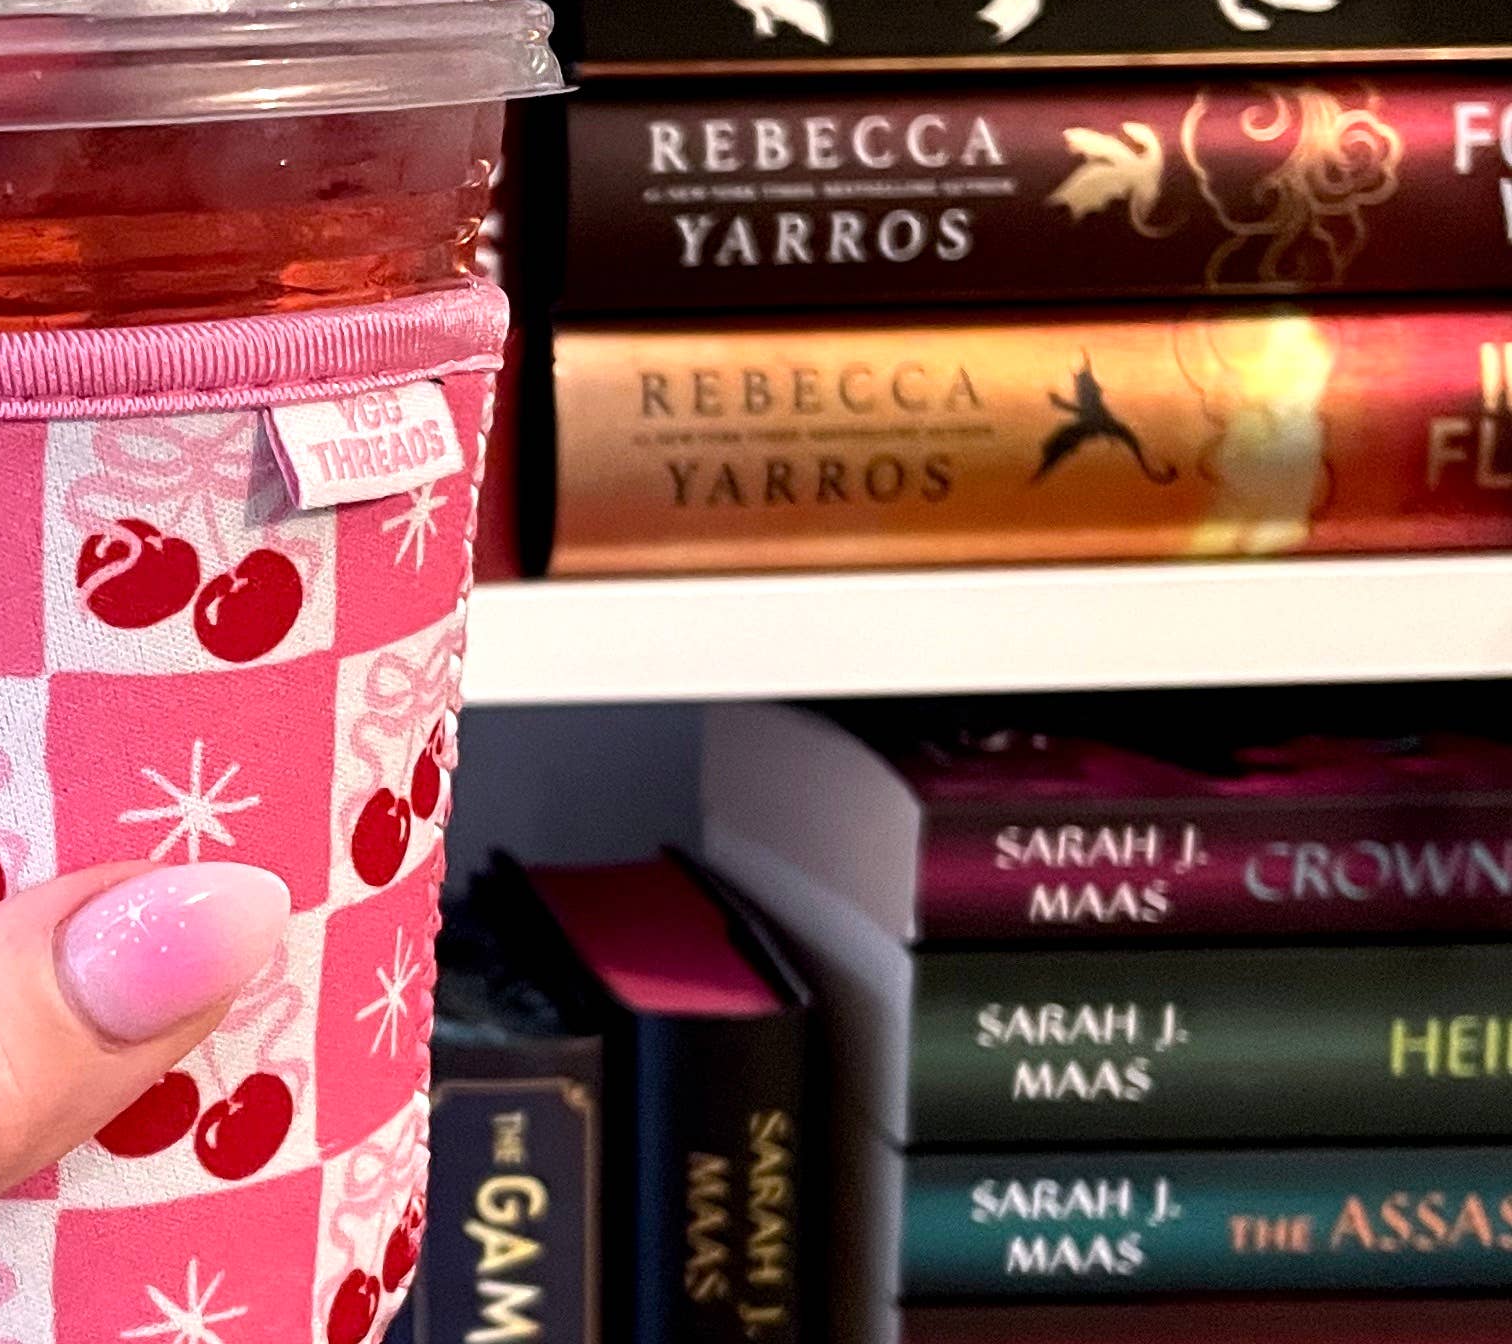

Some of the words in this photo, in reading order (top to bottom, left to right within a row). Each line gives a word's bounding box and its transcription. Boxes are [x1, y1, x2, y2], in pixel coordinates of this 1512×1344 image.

[646, 112, 1007, 176] REBECCA
[671, 206, 975, 268] YARROS
[637, 363, 985, 420] REBECCA
[307, 419, 448, 482] THREADS
[662, 455, 956, 509] YARROS
[994, 824, 1161, 871] SARAH
[1173, 821, 1209, 875] J.
[1029, 878, 1172, 923] MAAS
[976, 1001, 1142, 1047] SARAH
[1154, 1000, 1190, 1052] J.
[1390, 1015, 1512, 1077] HEI
[1012, 1056, 1155, 1103] MAAS
[489, 1110, 530, 1166] THE
[745, 1108, 794, 1287] SARAH
[970, 1176, 1130, 1223] SARAH
[1147, 1174, 1183, 1228] J.
[1229, 1212, 1312, 1254] THE
[1006, 1230, 1145, 1275] MAAS
